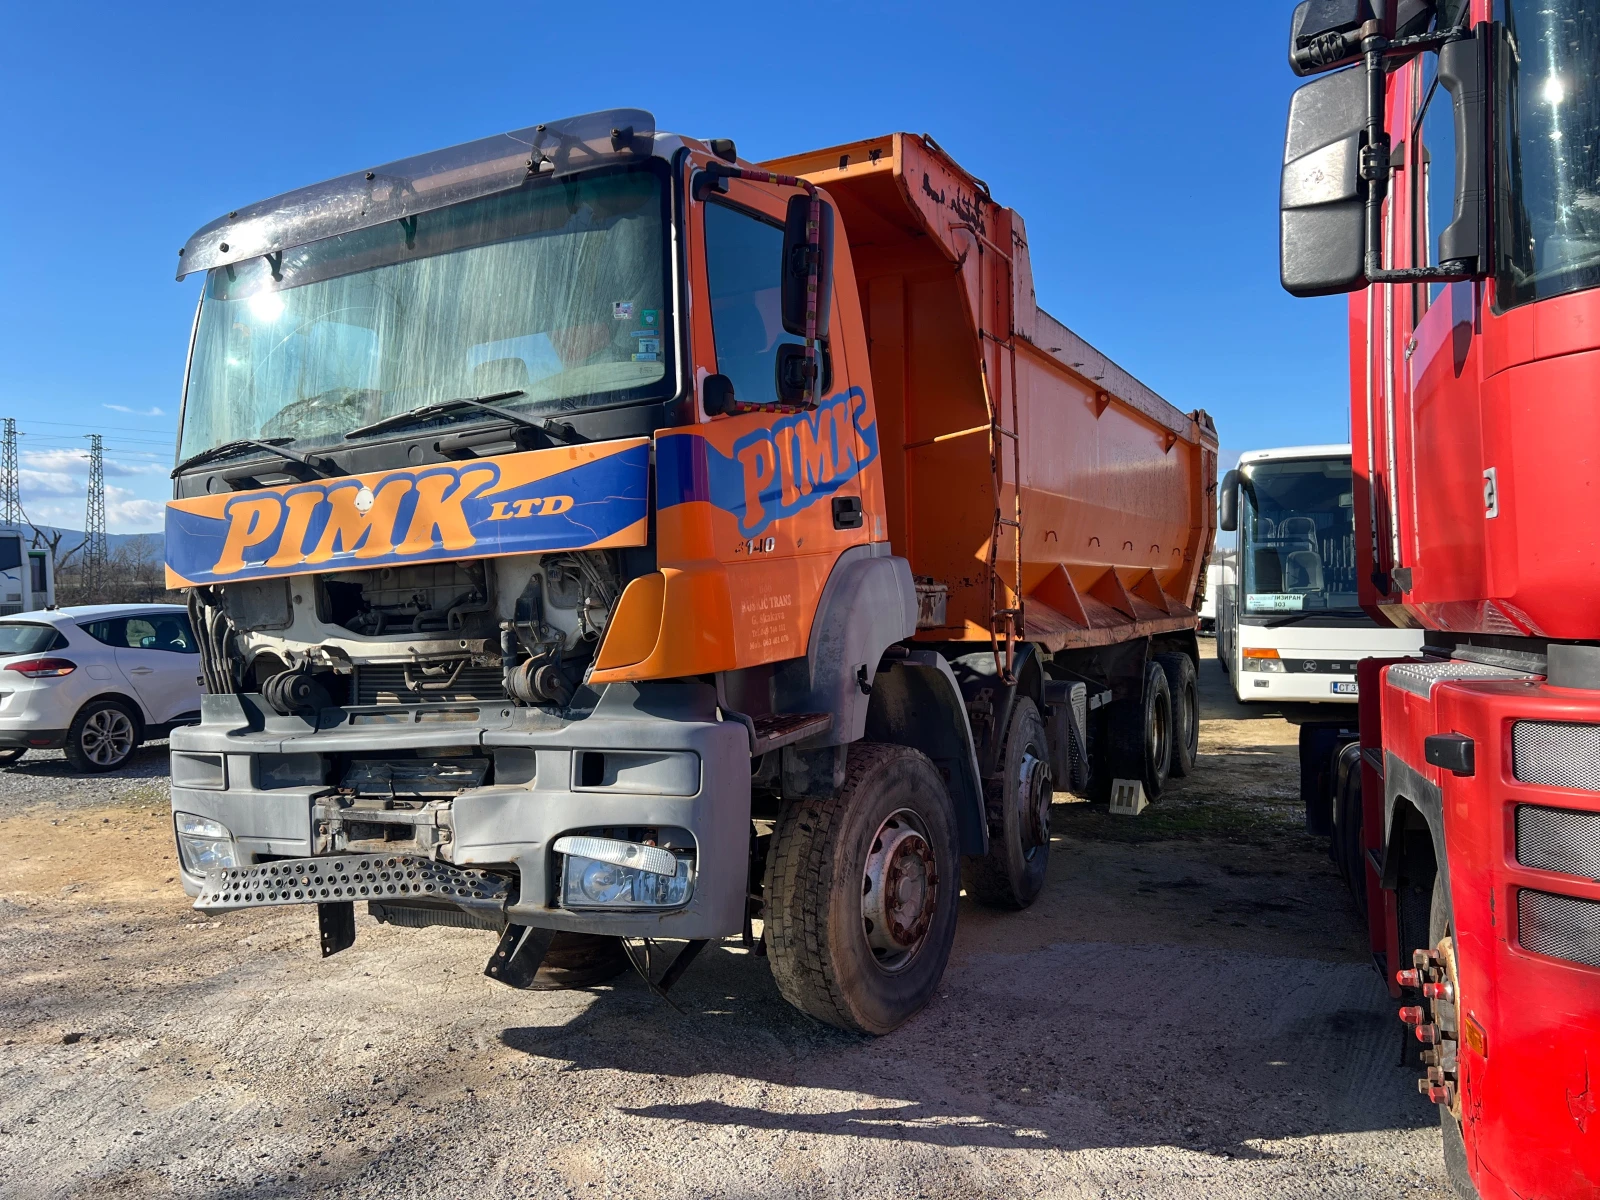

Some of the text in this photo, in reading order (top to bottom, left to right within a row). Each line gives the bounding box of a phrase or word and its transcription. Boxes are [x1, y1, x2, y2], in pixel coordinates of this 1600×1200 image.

[736, 392, 872, 530] PIMK
[212, 468, 575, 575] PIMK LTD
[769, 594, 792, 608] TRANS
